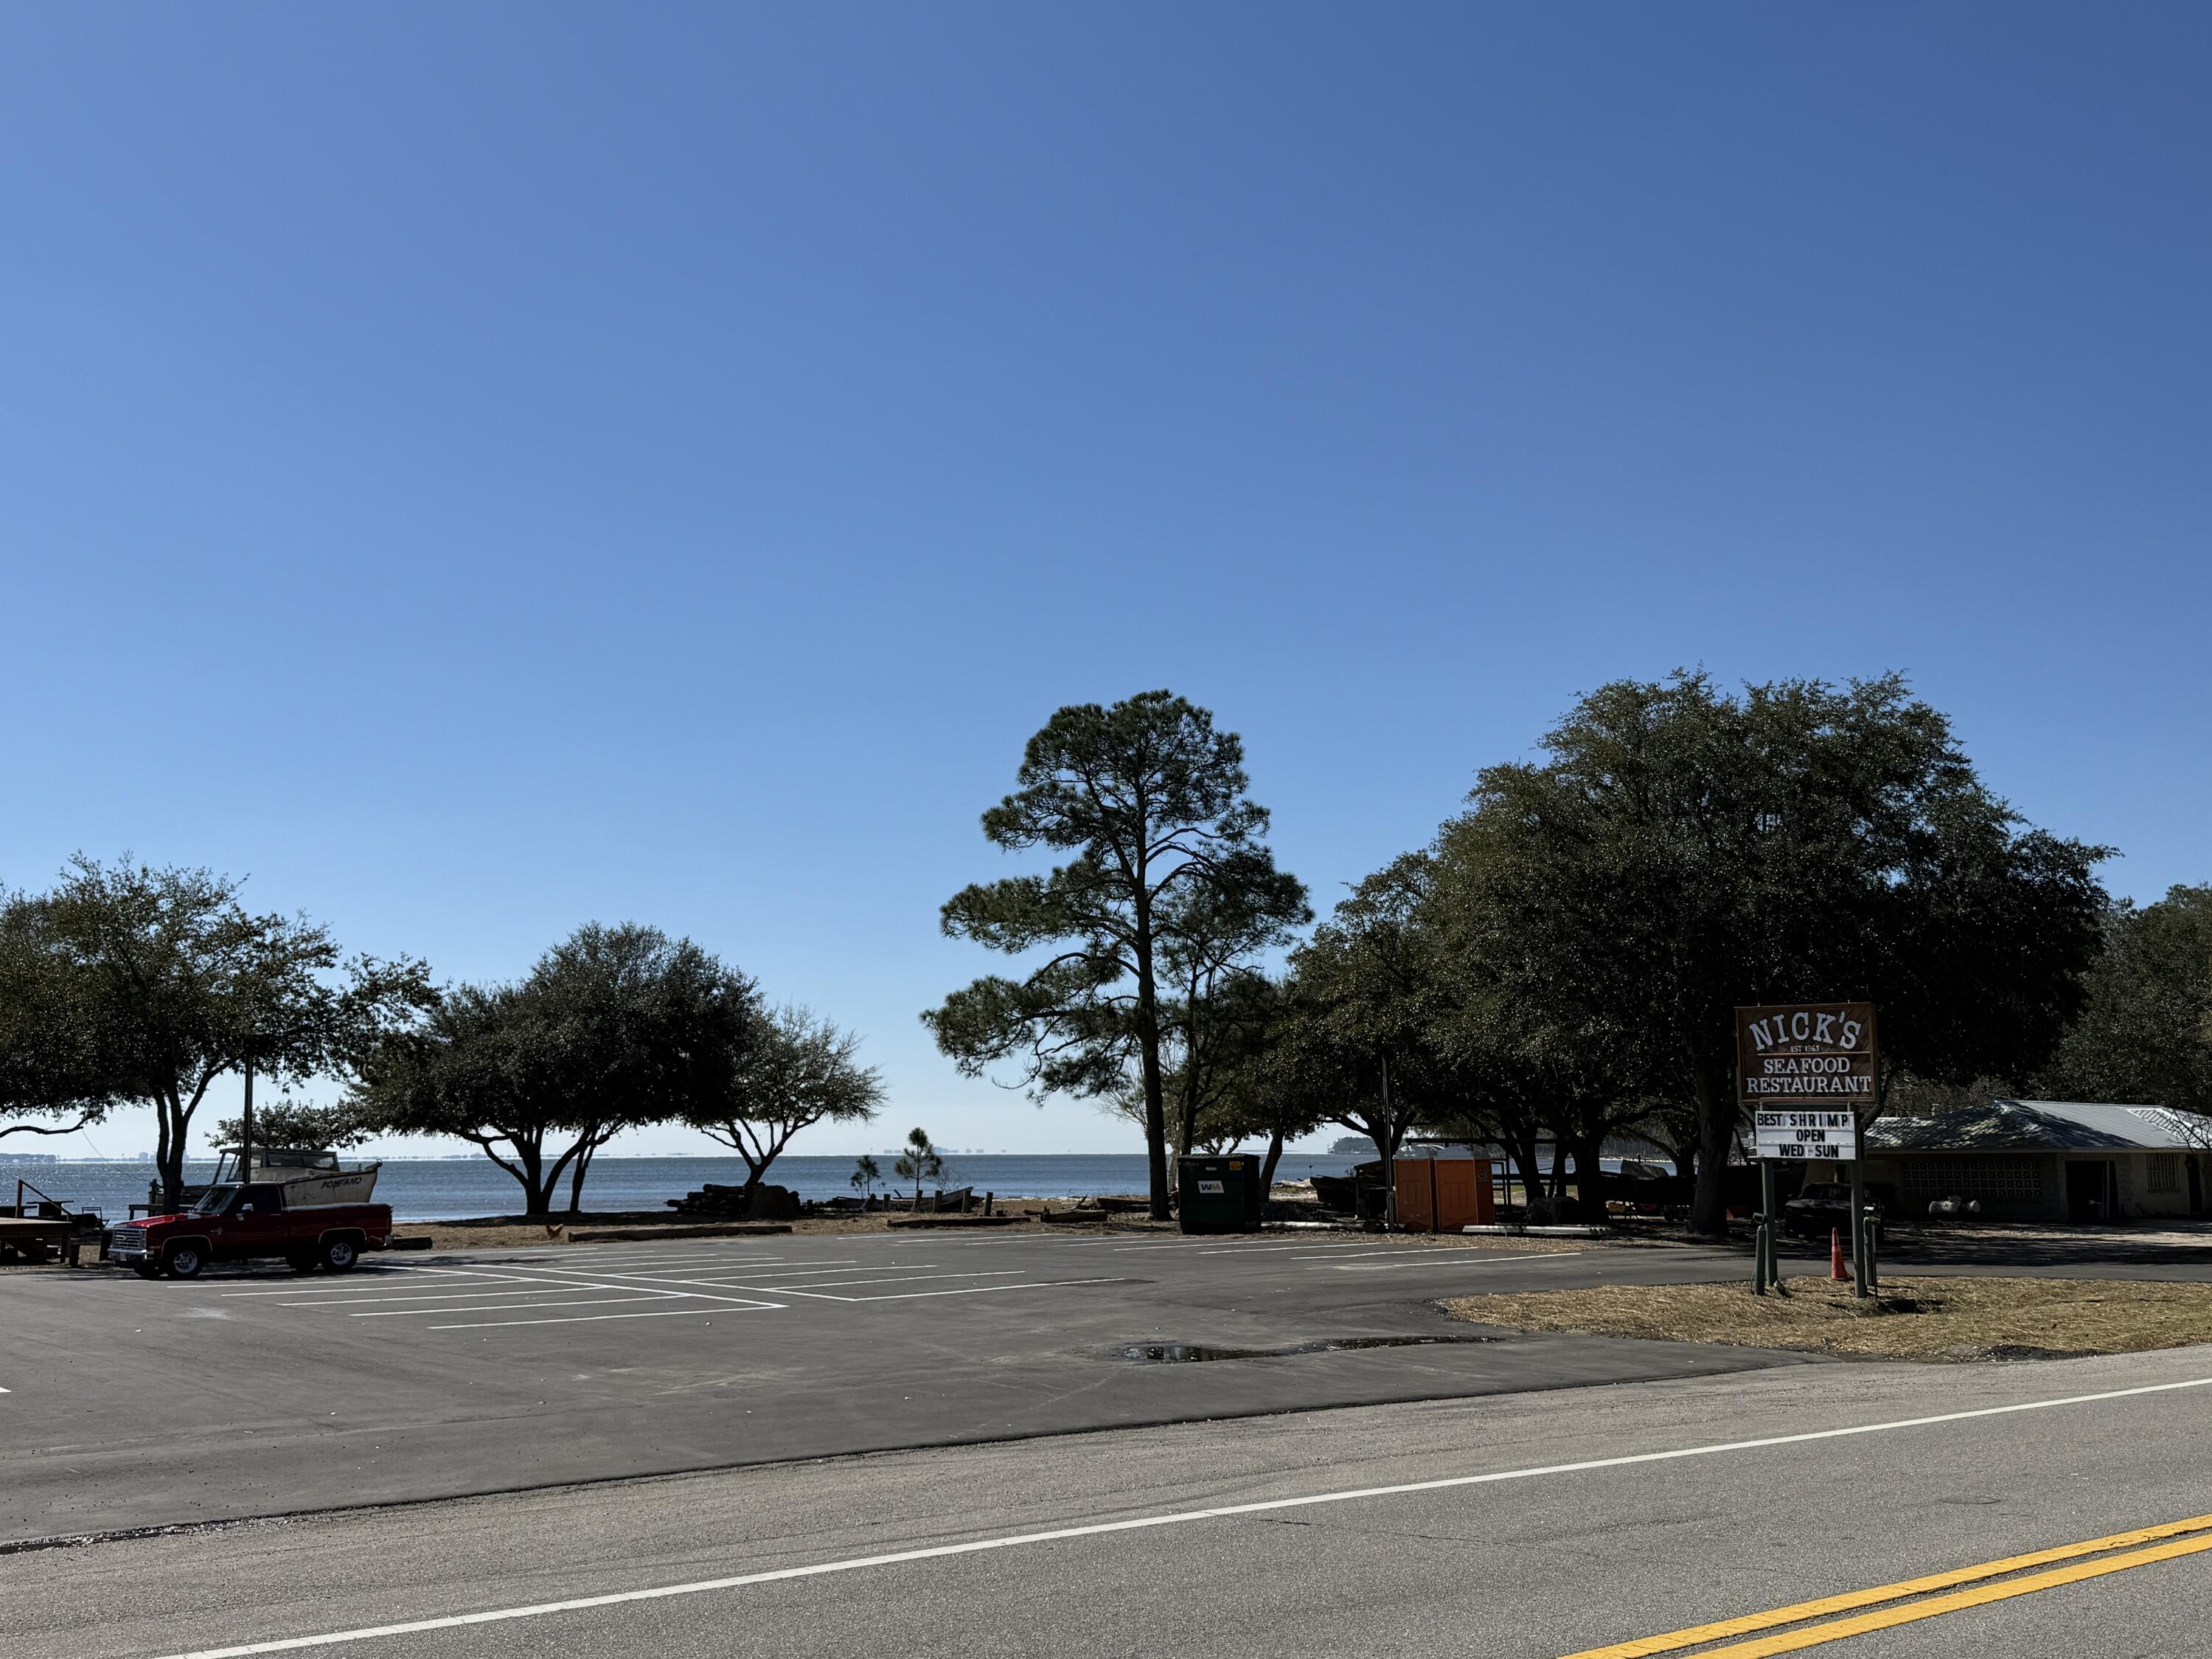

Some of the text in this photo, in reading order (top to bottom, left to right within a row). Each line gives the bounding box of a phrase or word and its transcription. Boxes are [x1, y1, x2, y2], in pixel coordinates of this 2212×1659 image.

[1749, 1012, 1862, 1051] NICK'S
[1764, 1057, 1851, 1074] SEAFOOD
[1746, 1076, 1871, 1093] RESTAURANT
[1757, 1113, 1848, 1127] BEST SHRIMP
[1796, 1129, 1826, 1142] OPEN
[320, 1177, 363, 1189] POMPANO
